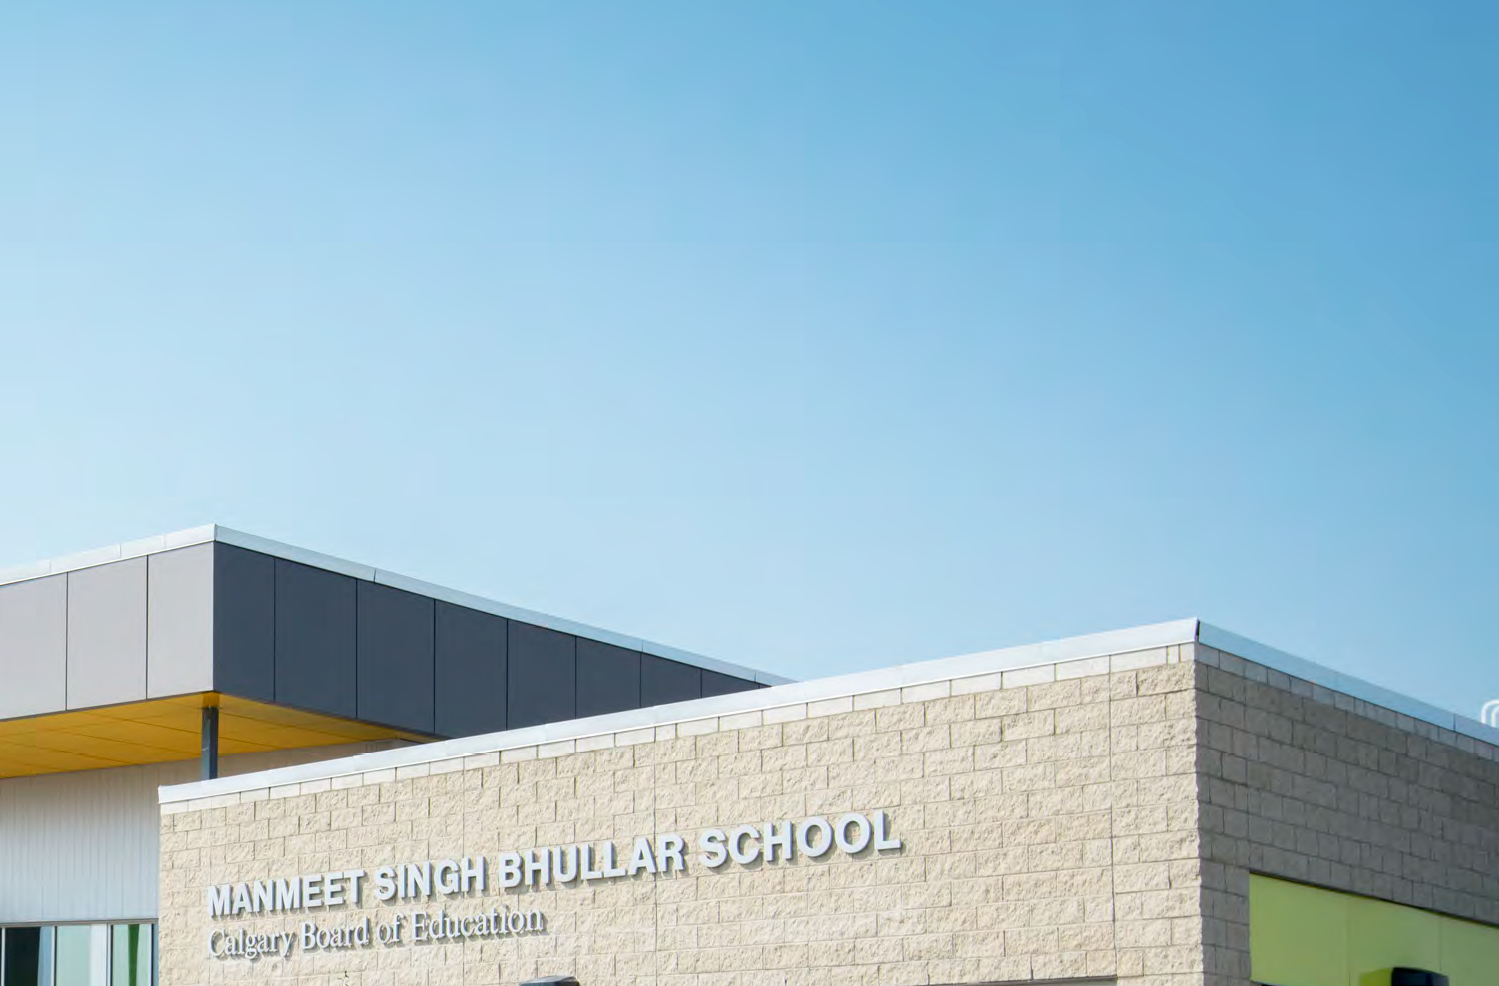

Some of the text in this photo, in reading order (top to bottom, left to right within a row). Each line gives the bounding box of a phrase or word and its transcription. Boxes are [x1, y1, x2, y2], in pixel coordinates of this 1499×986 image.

[207, 809, 902, 917] MANMEET SINGH BHULLAR SCHOOL
[208, 904, 545, 959] Calgary Board of Education
